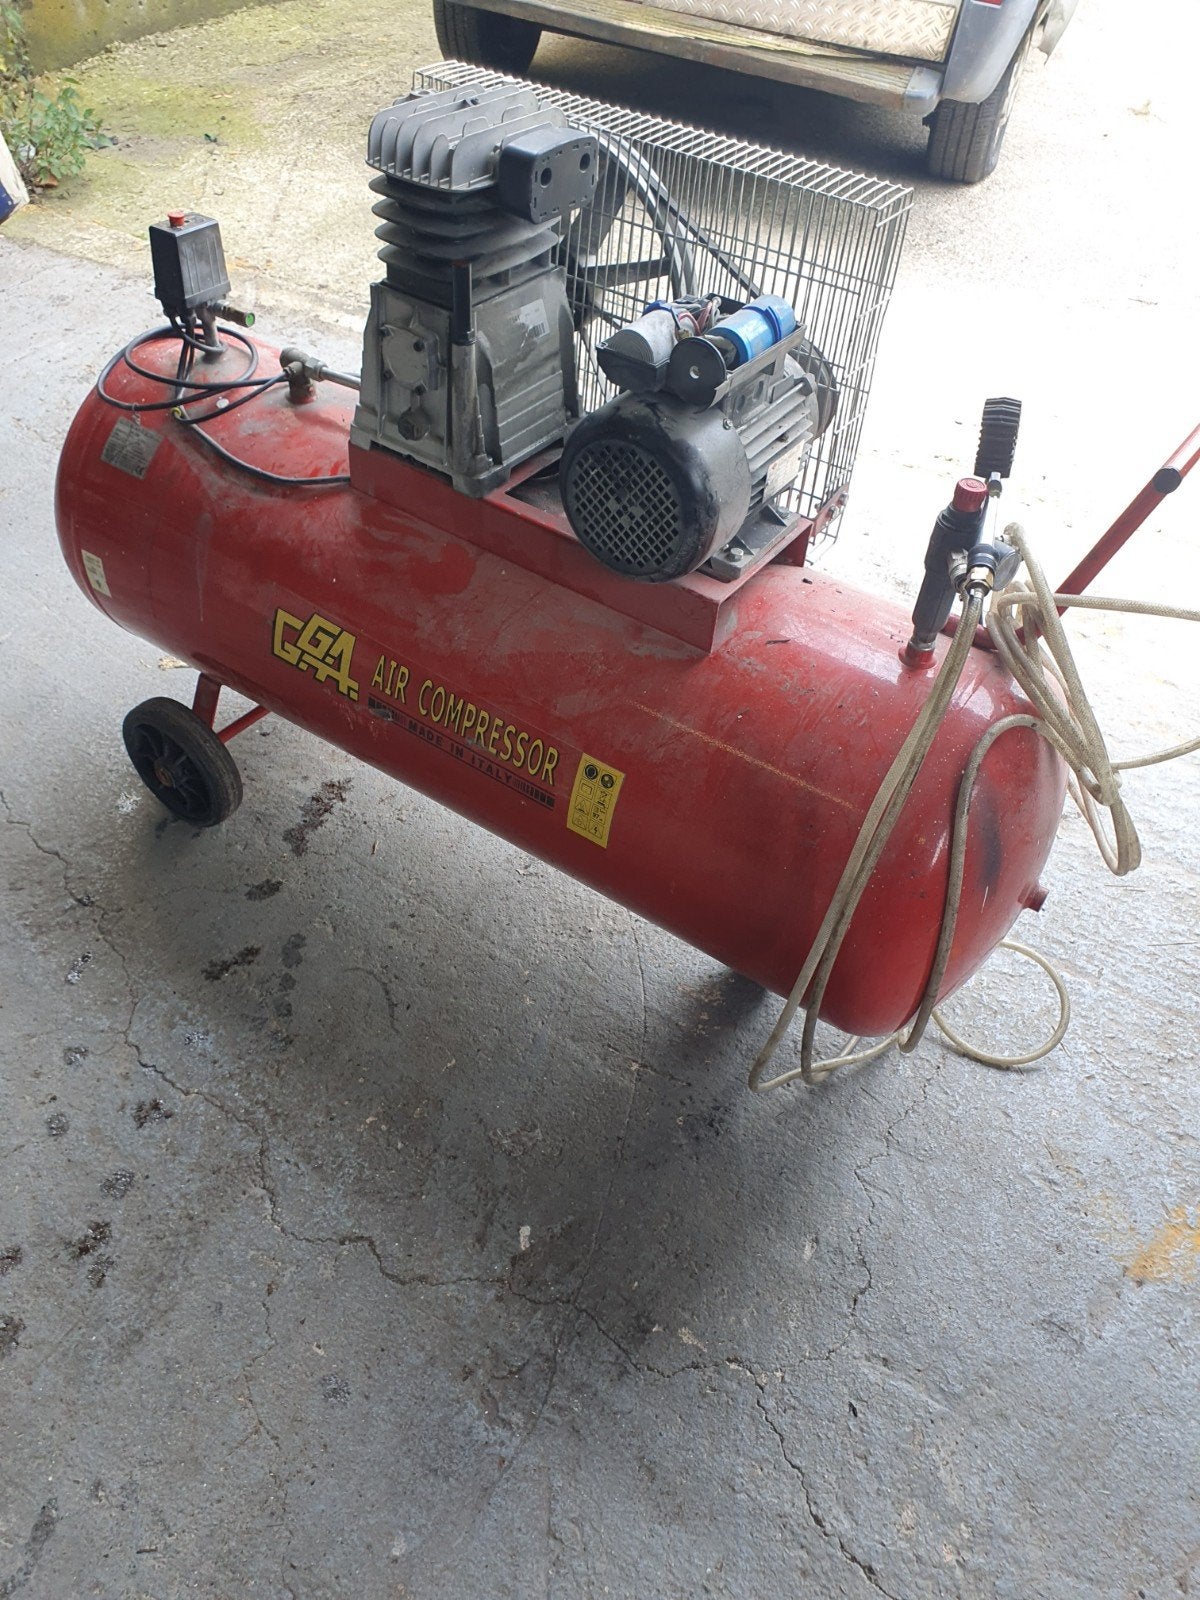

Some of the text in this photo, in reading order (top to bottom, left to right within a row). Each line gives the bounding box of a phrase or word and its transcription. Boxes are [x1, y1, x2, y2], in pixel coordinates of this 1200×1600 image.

[371, 654, 559, 786] AIR COMPRESSOR
[408, 720, 512, 783] MADE IN ITALY
